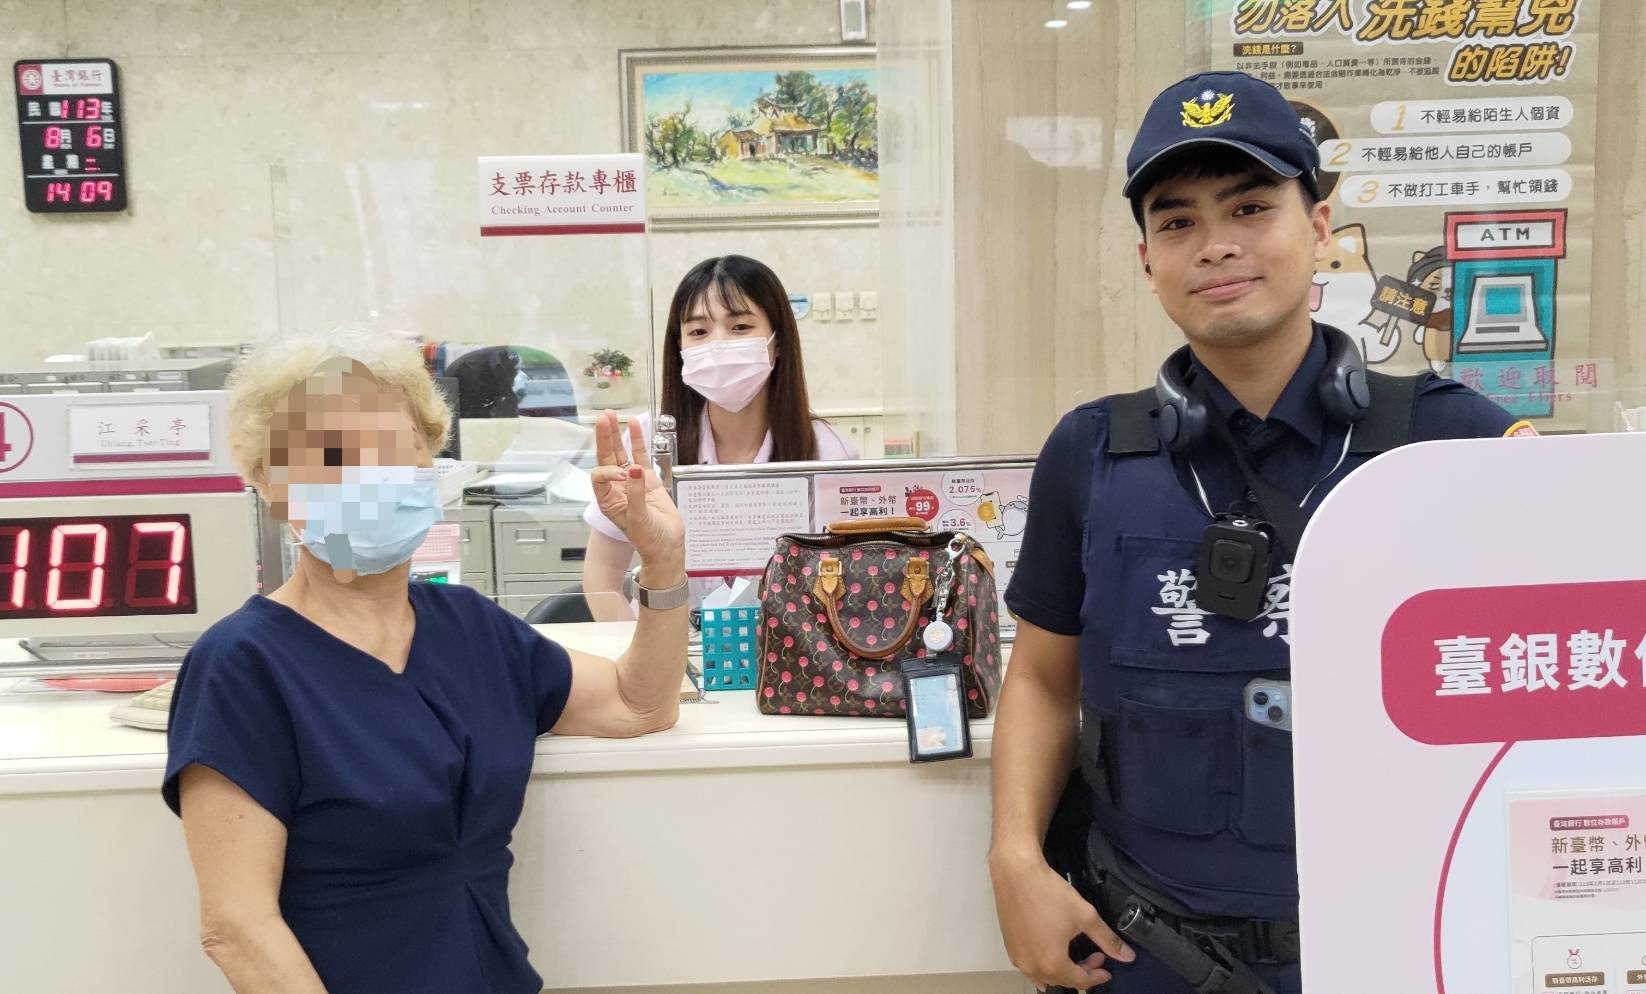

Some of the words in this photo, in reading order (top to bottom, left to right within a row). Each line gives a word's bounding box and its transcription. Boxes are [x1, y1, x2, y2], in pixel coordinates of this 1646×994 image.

[1391, 104, 1406, 131] 1
[1421, 106, 1560, 124] 不輕易給陌生人個資
[1329, 142, 1352, 166] 2
[1361, 142, 1532, 162] 不輕易給他人自己的帳戶
[489, 164, 638, 197] 支票存款專櫃
[47, 182, 71, 202] 14
[80, 181, 113, 202] 09
[1358, 180, 1379, 203] 3
[491, 205, 540, 215] Checking
[544, 204, 586, 214] Account
[591, 203, 634, 213] Counter
[1480, 227, 1530, 241] ATM
[1552, 833, 1646, 854] 新臺幣、外
[1552, 855, 1642, 876] 一起享高利
